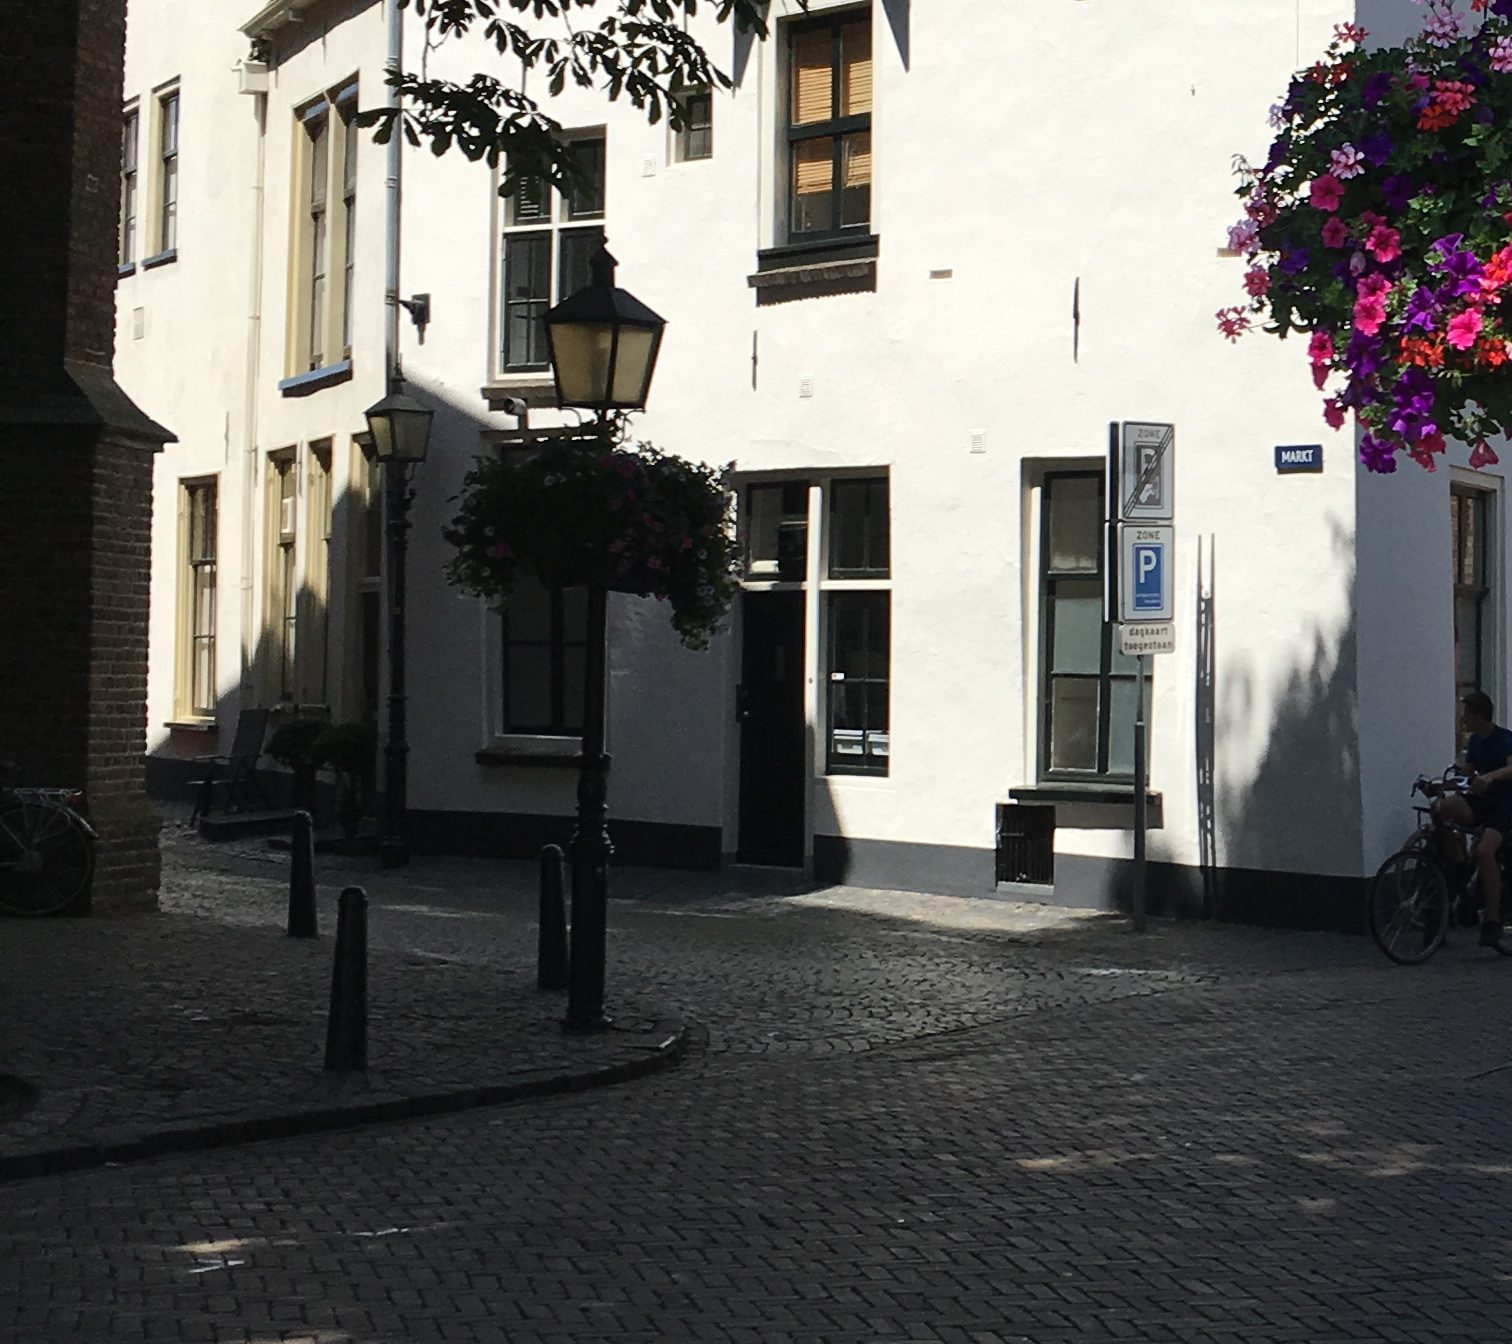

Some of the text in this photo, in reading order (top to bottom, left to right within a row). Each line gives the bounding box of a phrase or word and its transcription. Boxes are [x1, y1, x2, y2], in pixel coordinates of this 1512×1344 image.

[1138, 429, 1161, 438] ZONE
[1281, 450, 1313, 463] MARKT
[1137, 531, 1161, 540] ZONE
[1139, 549, 1157, 584] P
[1129, 627, 1168, 638] dagkaart
